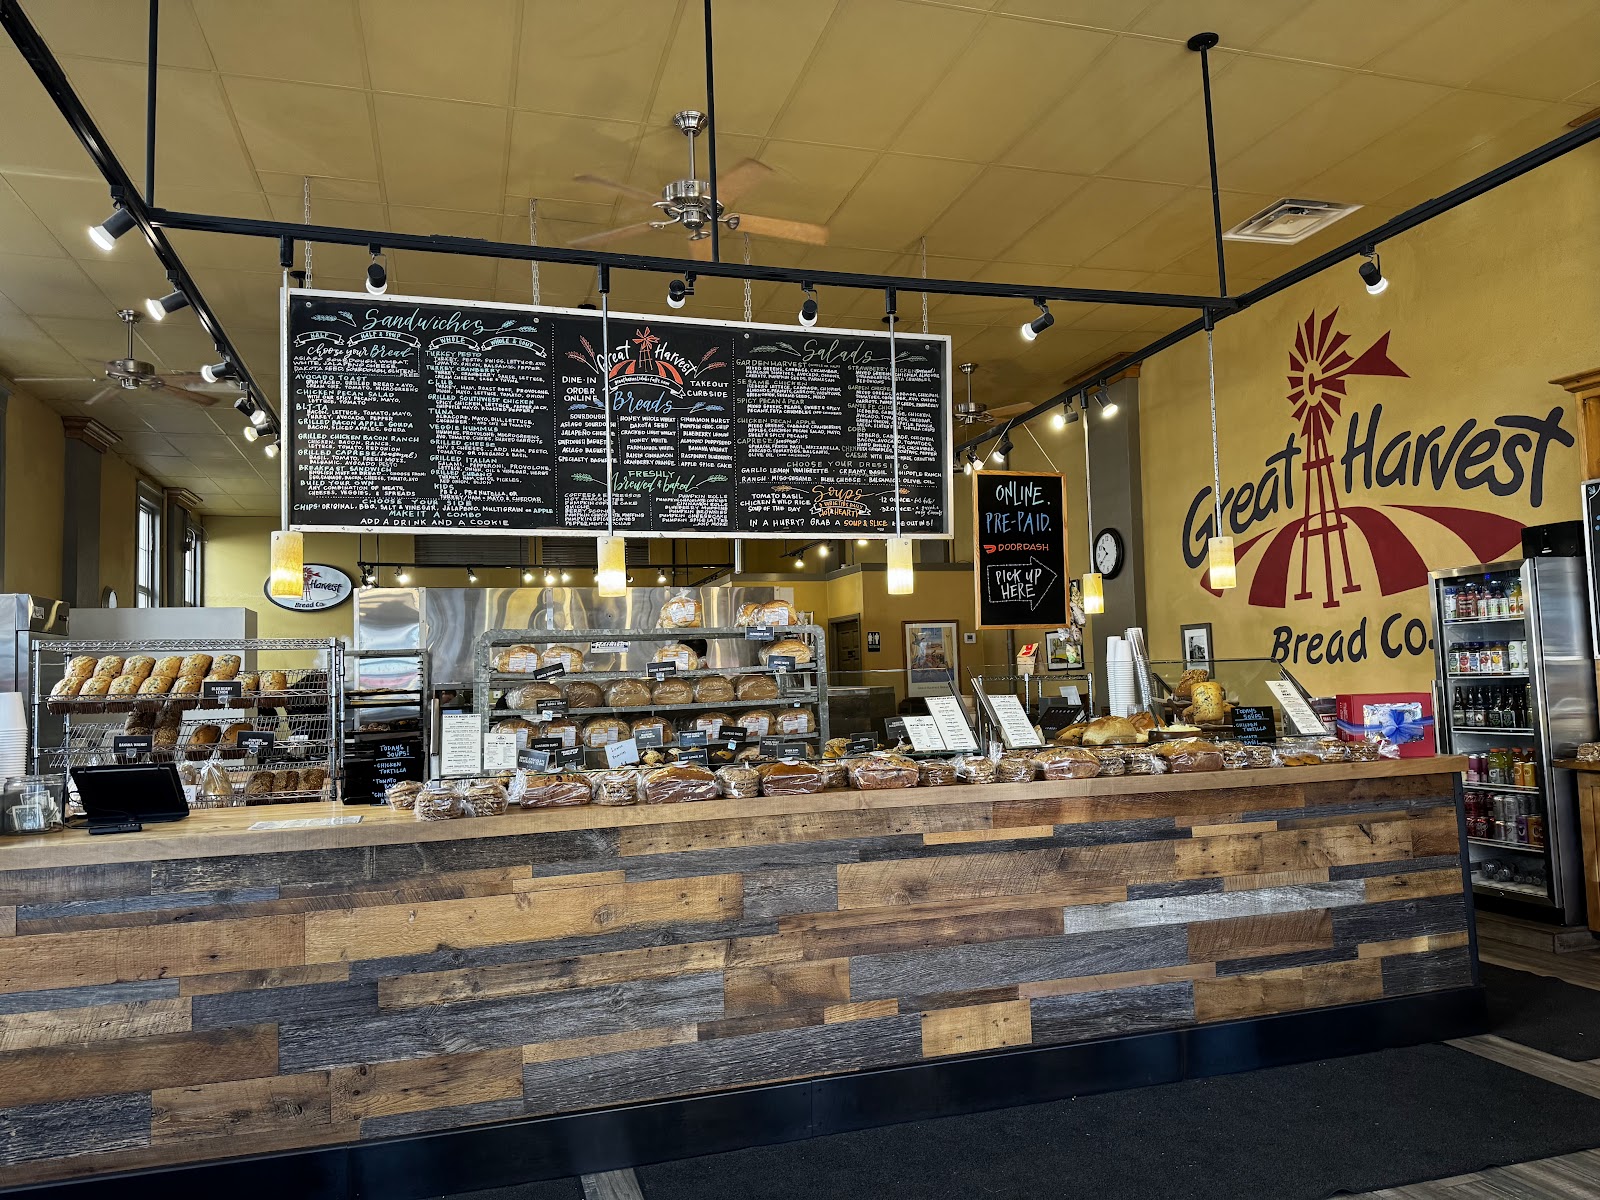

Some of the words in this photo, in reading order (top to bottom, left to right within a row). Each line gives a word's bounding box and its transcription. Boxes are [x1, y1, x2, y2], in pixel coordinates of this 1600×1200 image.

[362, 308, 484, 335] Sandwiches
[307, 343, 344, 357] Choose
[344, 348, 369, 361] your
[370, 345, 414, 358] Bread
[596, 340, 631, 372] Great
[654, 342, 697, 376] Harvest
[802, 339, 872, 364] Salads
[613, 391, 673, 414] Breads
[612, 471, 656, 492] brewed
[663, 474, 695, 494] baked
[812, 485, 862, 502] Soups
[1182, 433, 1302, 569] Great
[1340, 403, 1575, 508] Harvest
[835, 508, 859, 518] HEARTY
[986, 511, 1052, 535] PRE-PAID.
[309, 579, 343, 593] Harvest
[995, 569, 1022, 585] PICK
[1026, 568, 1042, 585] UP
[1001, 583, 1036, 599] HERE
[1272, 616, 1367, 665] Bread
[1380, 613, 1434, 659] Co.
